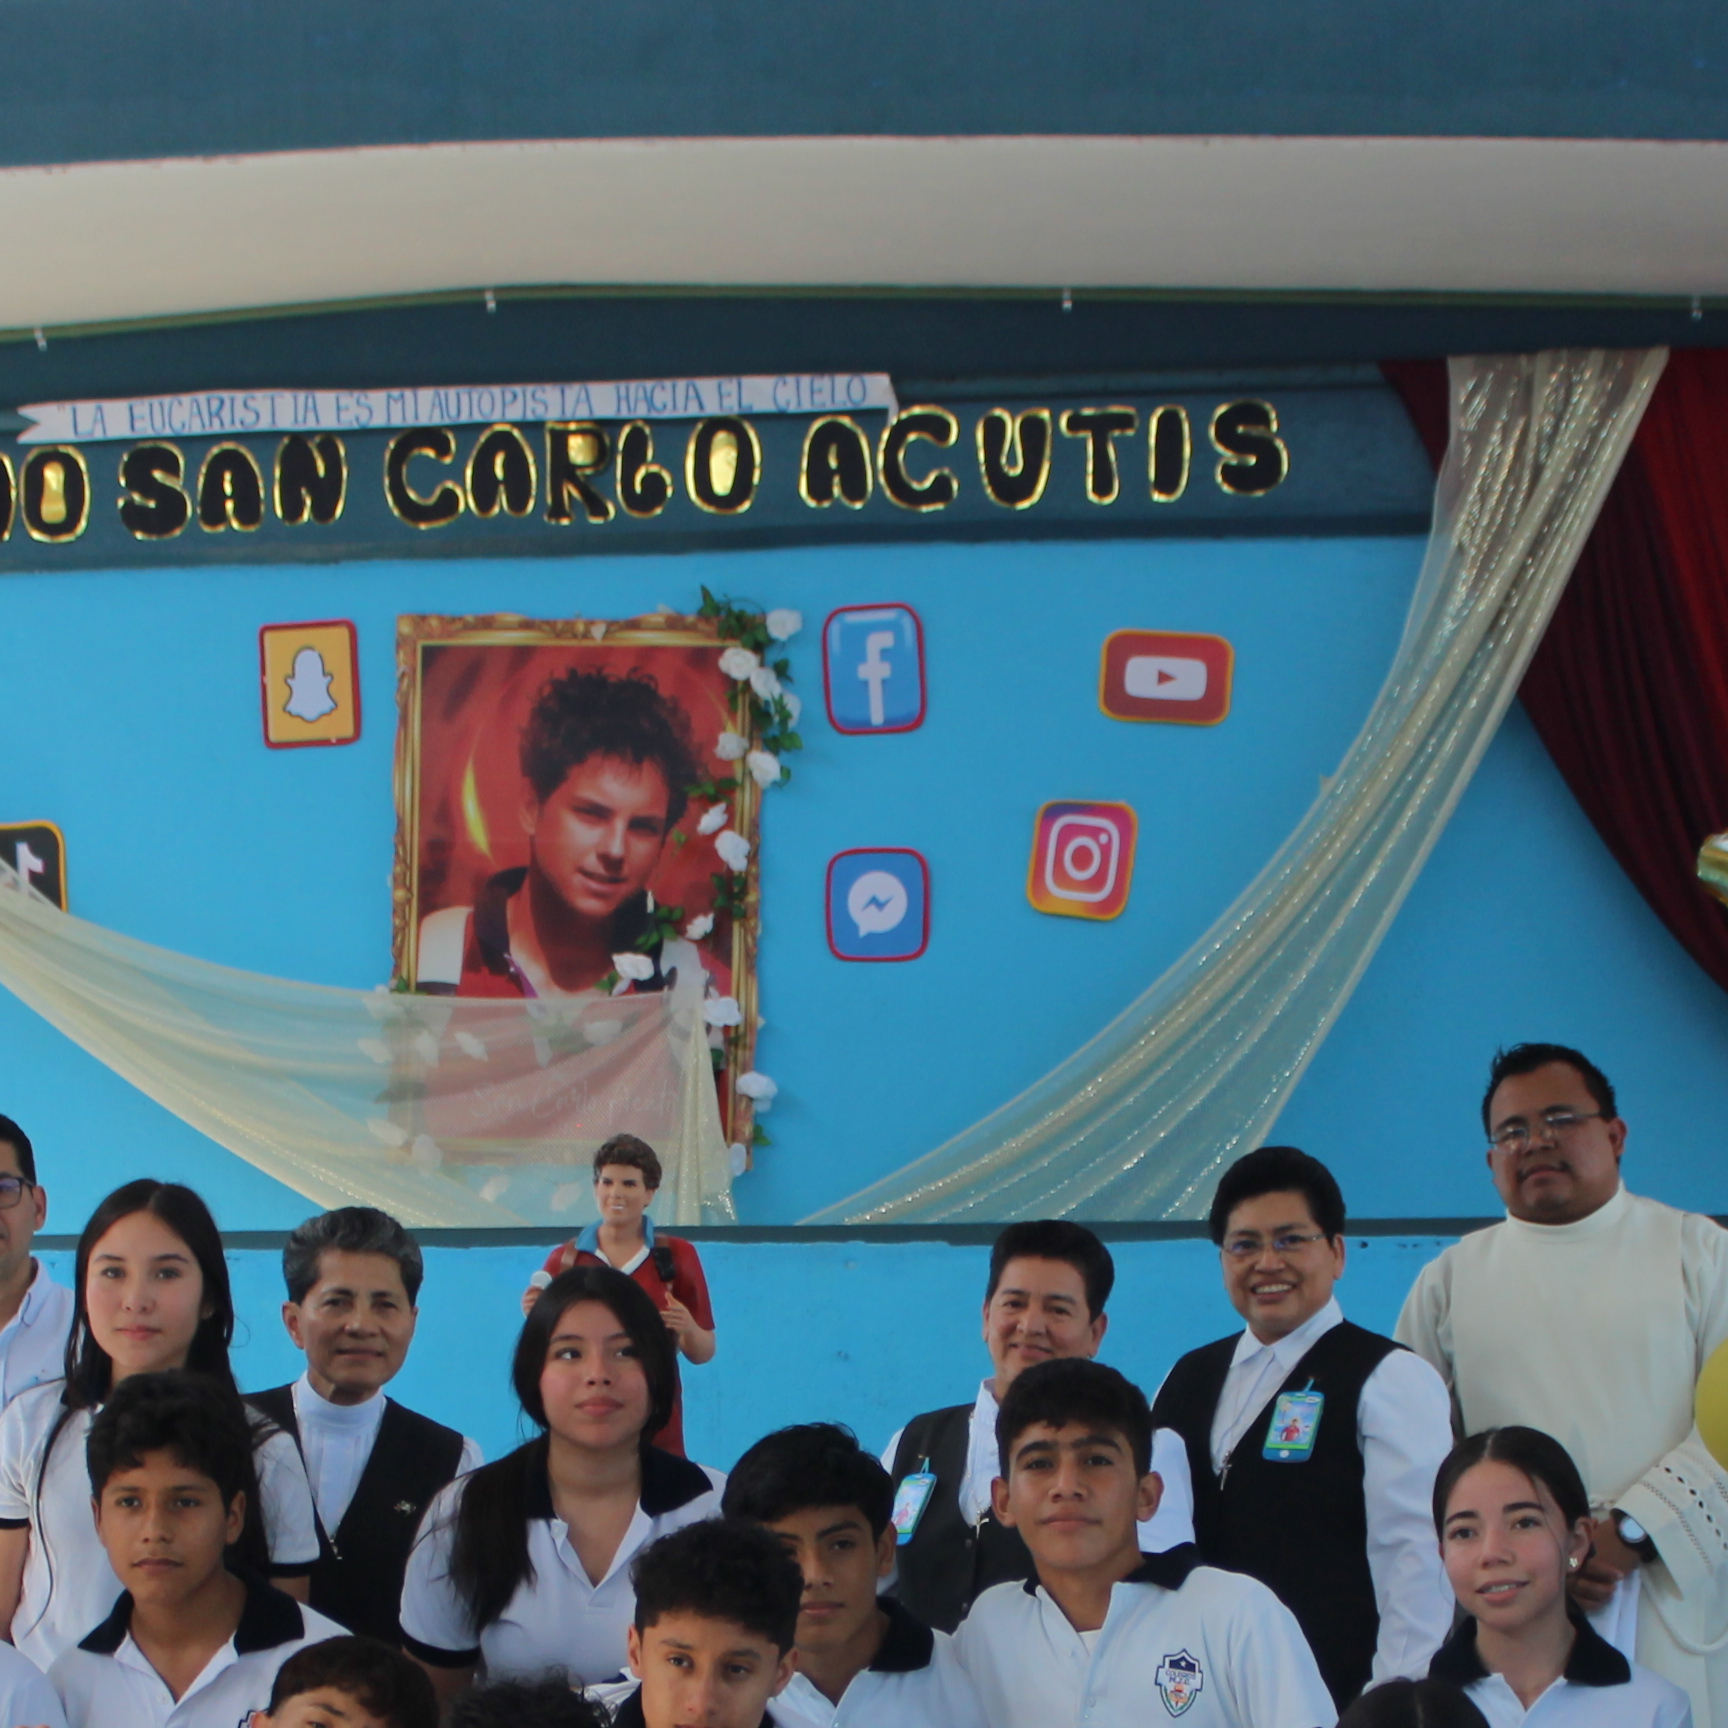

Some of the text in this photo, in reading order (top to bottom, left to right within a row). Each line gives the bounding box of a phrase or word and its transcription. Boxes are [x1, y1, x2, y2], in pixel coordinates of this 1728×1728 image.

[127, 391, 320, 436] EUCARISTIA
[335, 390, 374, 429] ES
[385, 388, 420, 425] MI
[429, 383, 594, 422] AUTOPISTA
[614, 380, 707, 415] HACIA
[717, 376, 754, 413] EL
[773, 374, 868, 412] CIELO
[117, 433, 349, 541] SAN
[383, 414, 763, 530] CARLO
[798, 400, 1289, 513] ACUTIS
